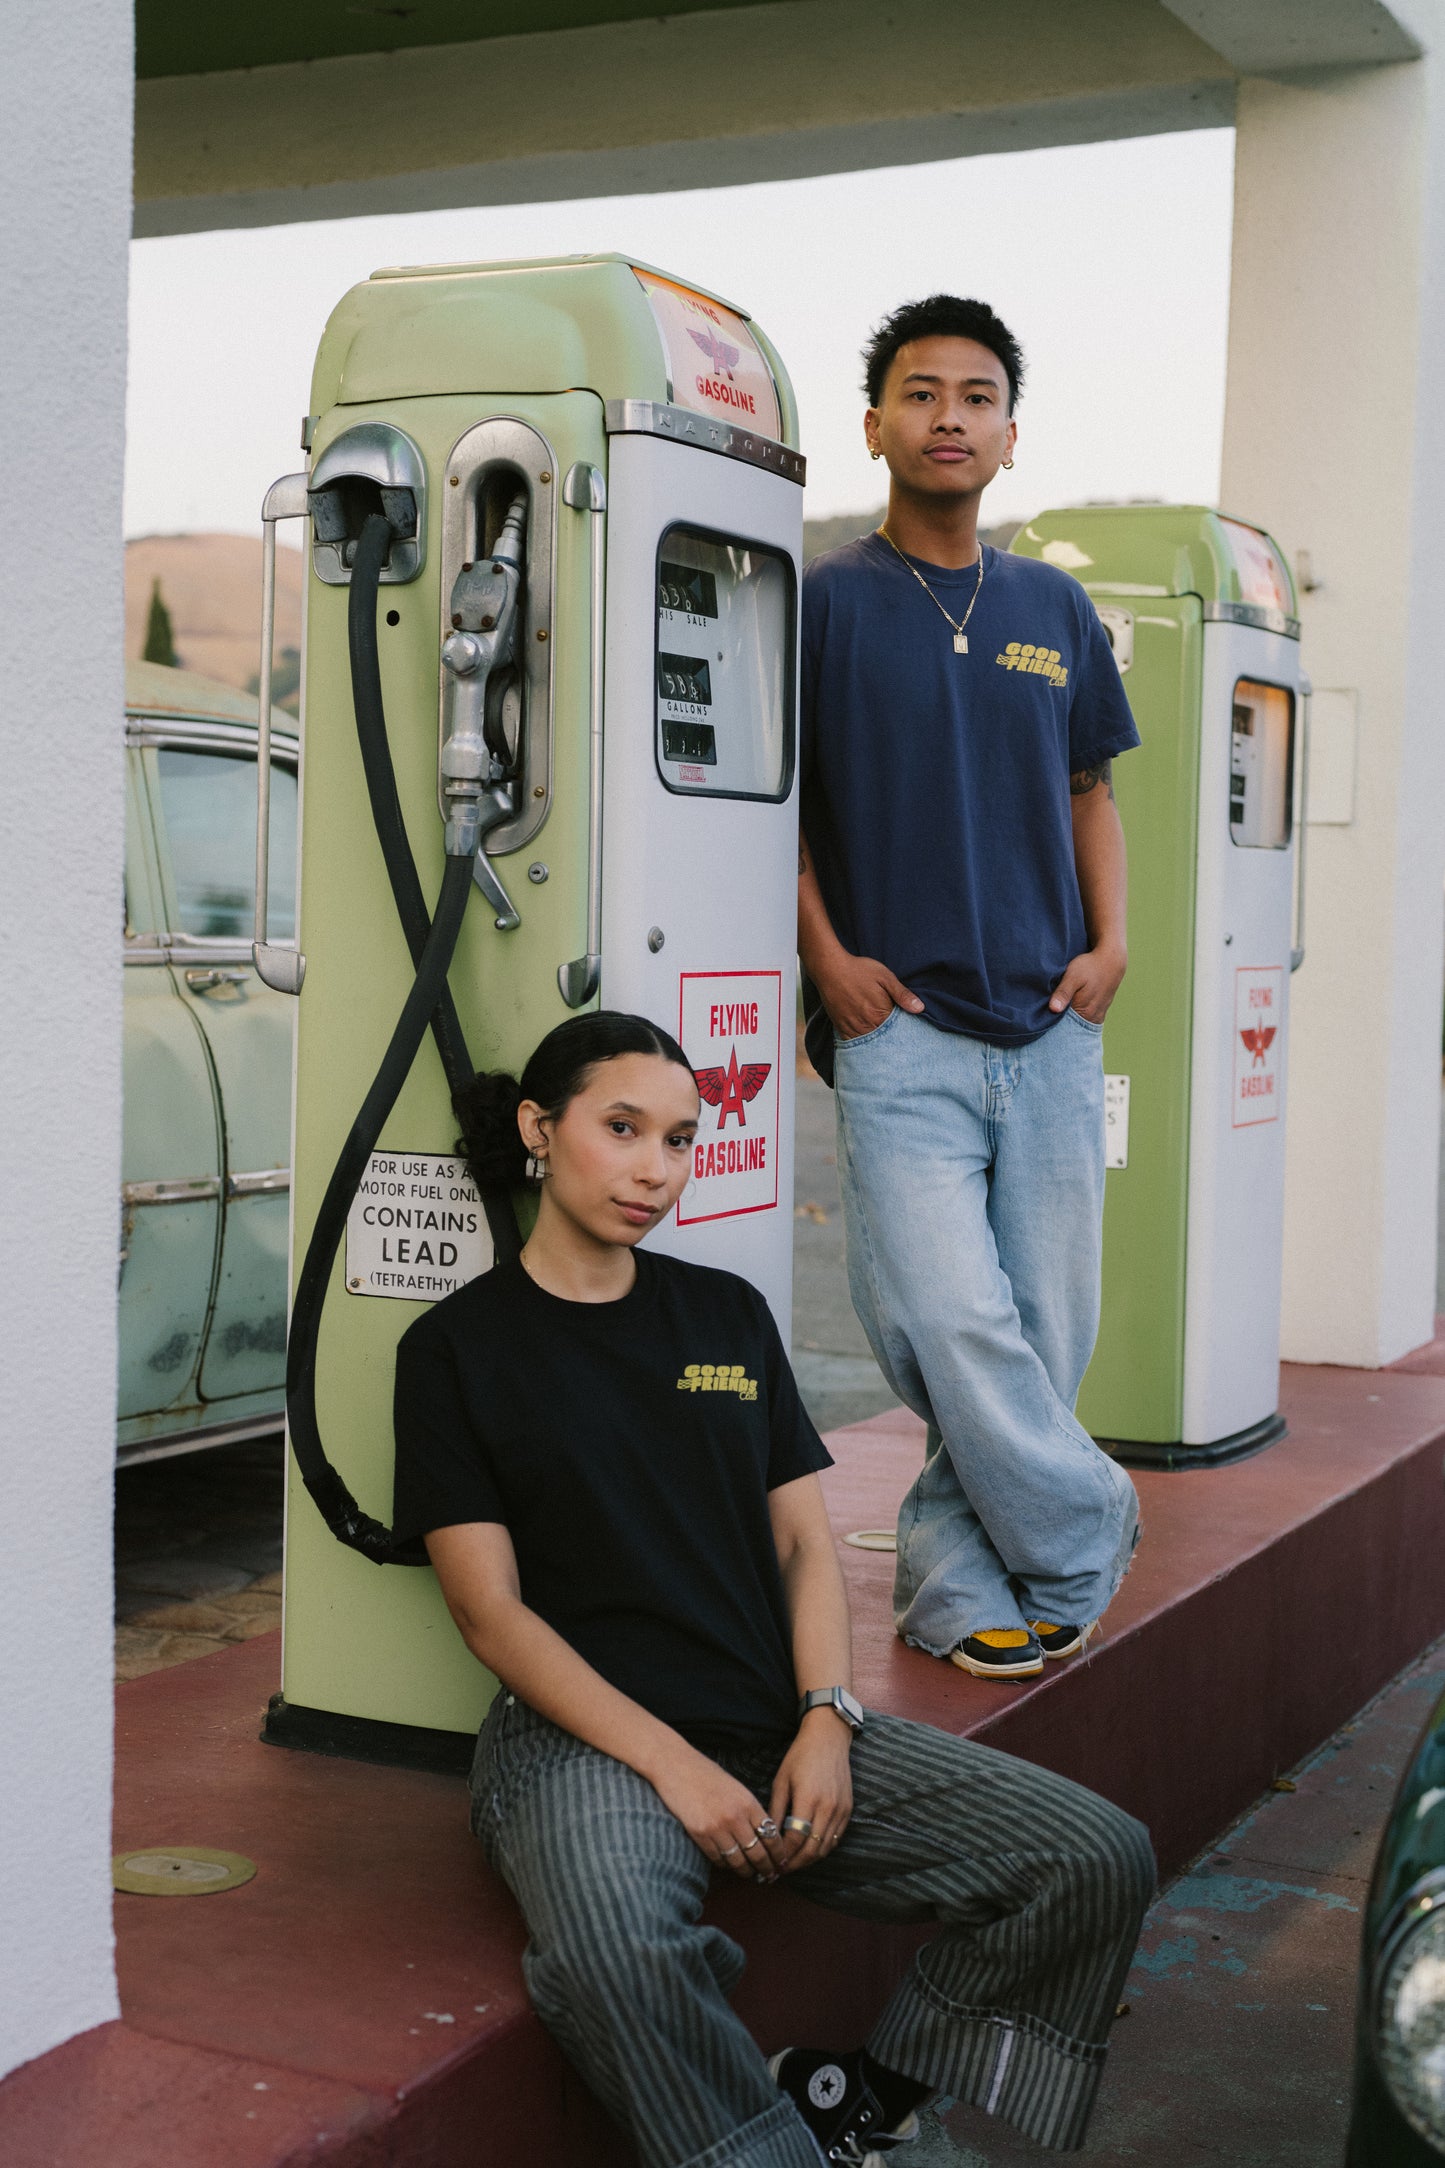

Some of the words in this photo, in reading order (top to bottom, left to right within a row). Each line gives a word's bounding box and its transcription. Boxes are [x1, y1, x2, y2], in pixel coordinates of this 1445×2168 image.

[695, 374, 756, 415] GASOLINE
[687, 614, 707, 628] SALE
[1005, 642, 1061, 664] GOOD
[1005, 655, 1068, 682] FRIENDS
[667, 701, 707, 716] GALLONS
[1249, 988, 1273, 1008] FLYING
[710, 1002, 759, 1037] FLYING
[1241, 1075, 1275, 1099] GASOLINE
[371, 1159, 397, 1175] FOR
[402, 1162, 428, 1177] USE
[435, 1164, 455, 1179] AS
[694, 1136, 766, 1179] GASOLINE
[356, 1180, 405, 1197] MOTOR
[411, 1184, 443, 1200] FUEL
[450, 1187, 483, 1203] ONL
[363, 1205, 477, 1233] CONTAINS
[382, 1237, 458, 1267] LEAD
[684, 1364, 746, 1378] GOOD
[690, 1376, 758, 1393] FRIENDS
